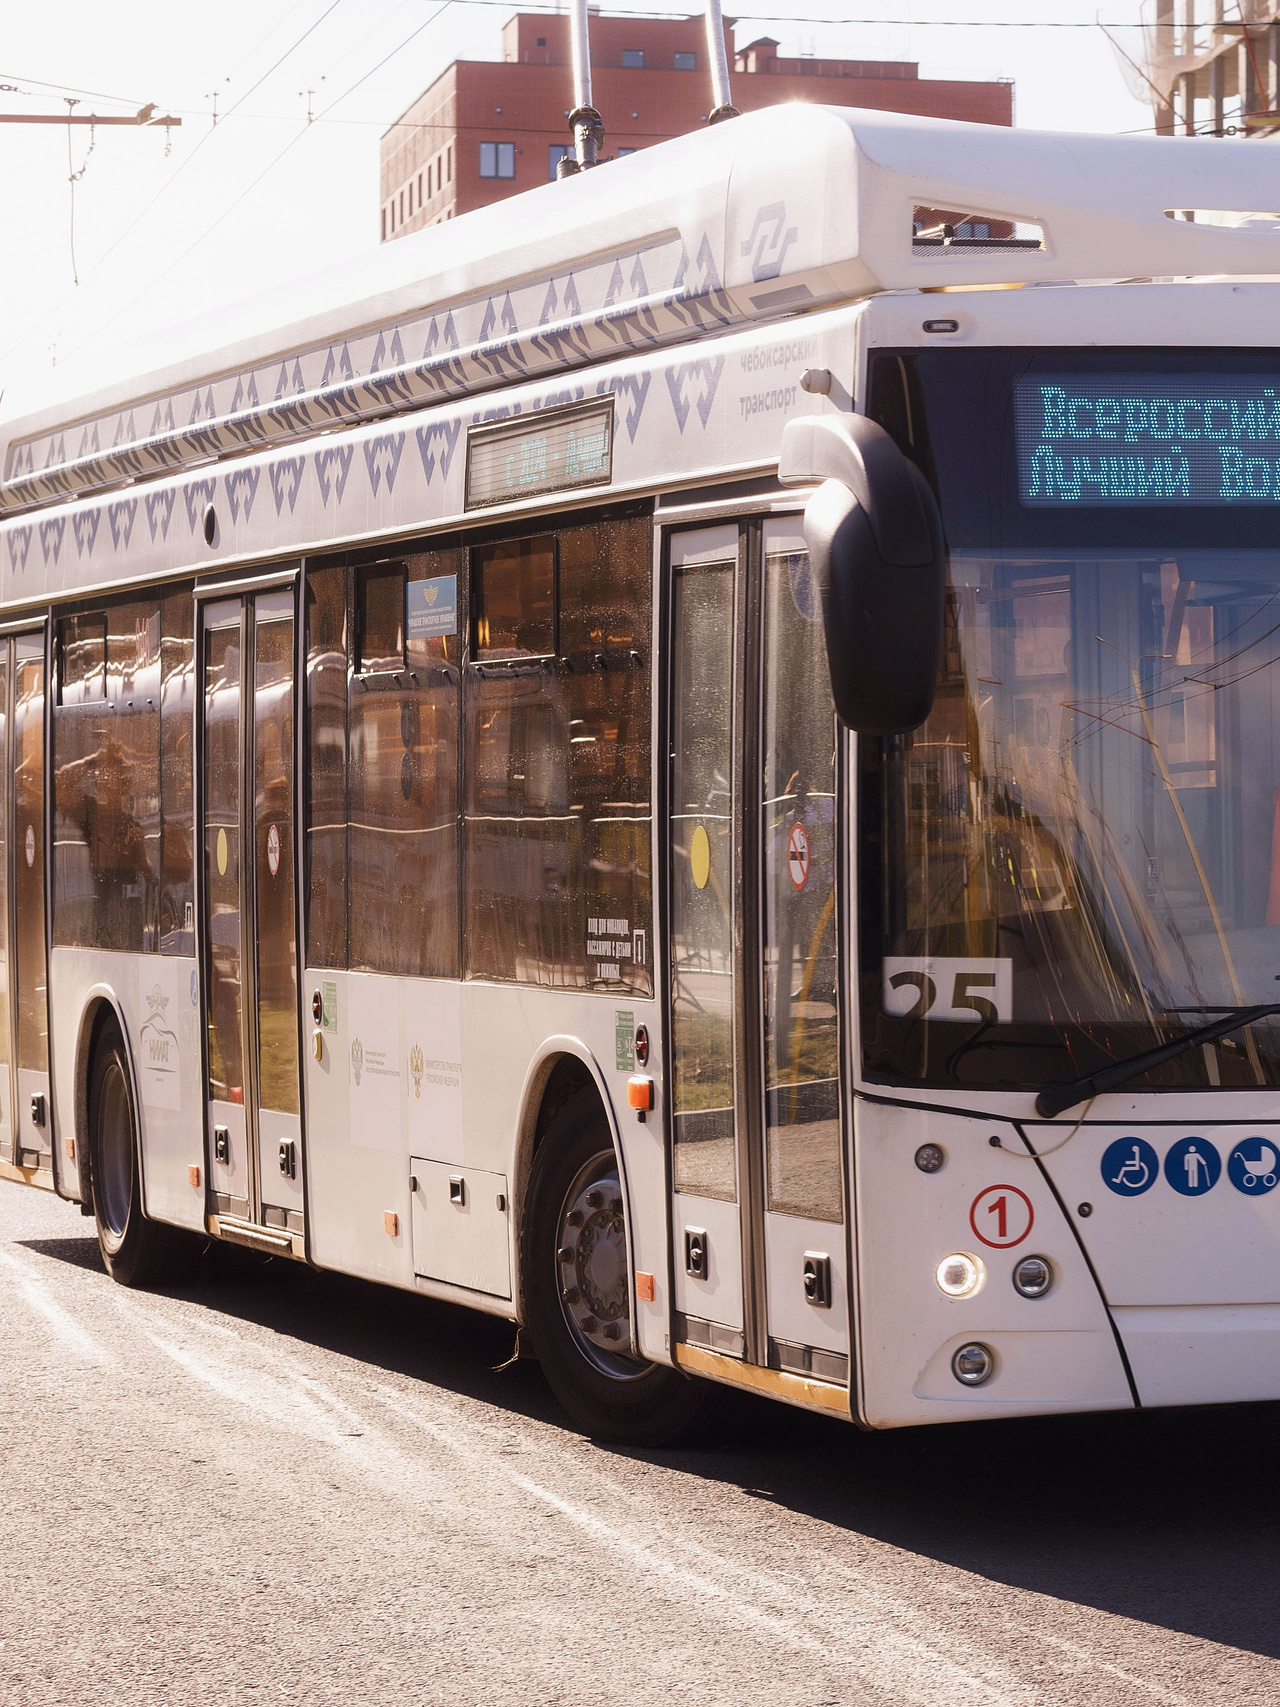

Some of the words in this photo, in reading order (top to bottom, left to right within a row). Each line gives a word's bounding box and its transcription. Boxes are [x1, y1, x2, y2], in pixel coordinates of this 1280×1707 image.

[741, 333, 818, 373] чебоксарский
[739, 385, 797, 422] транспорт
[1028, 444, 1189, 499] Лучший
[888, 971, 999, 1021] 25
[988, 1196, 1007, 1238] 1
